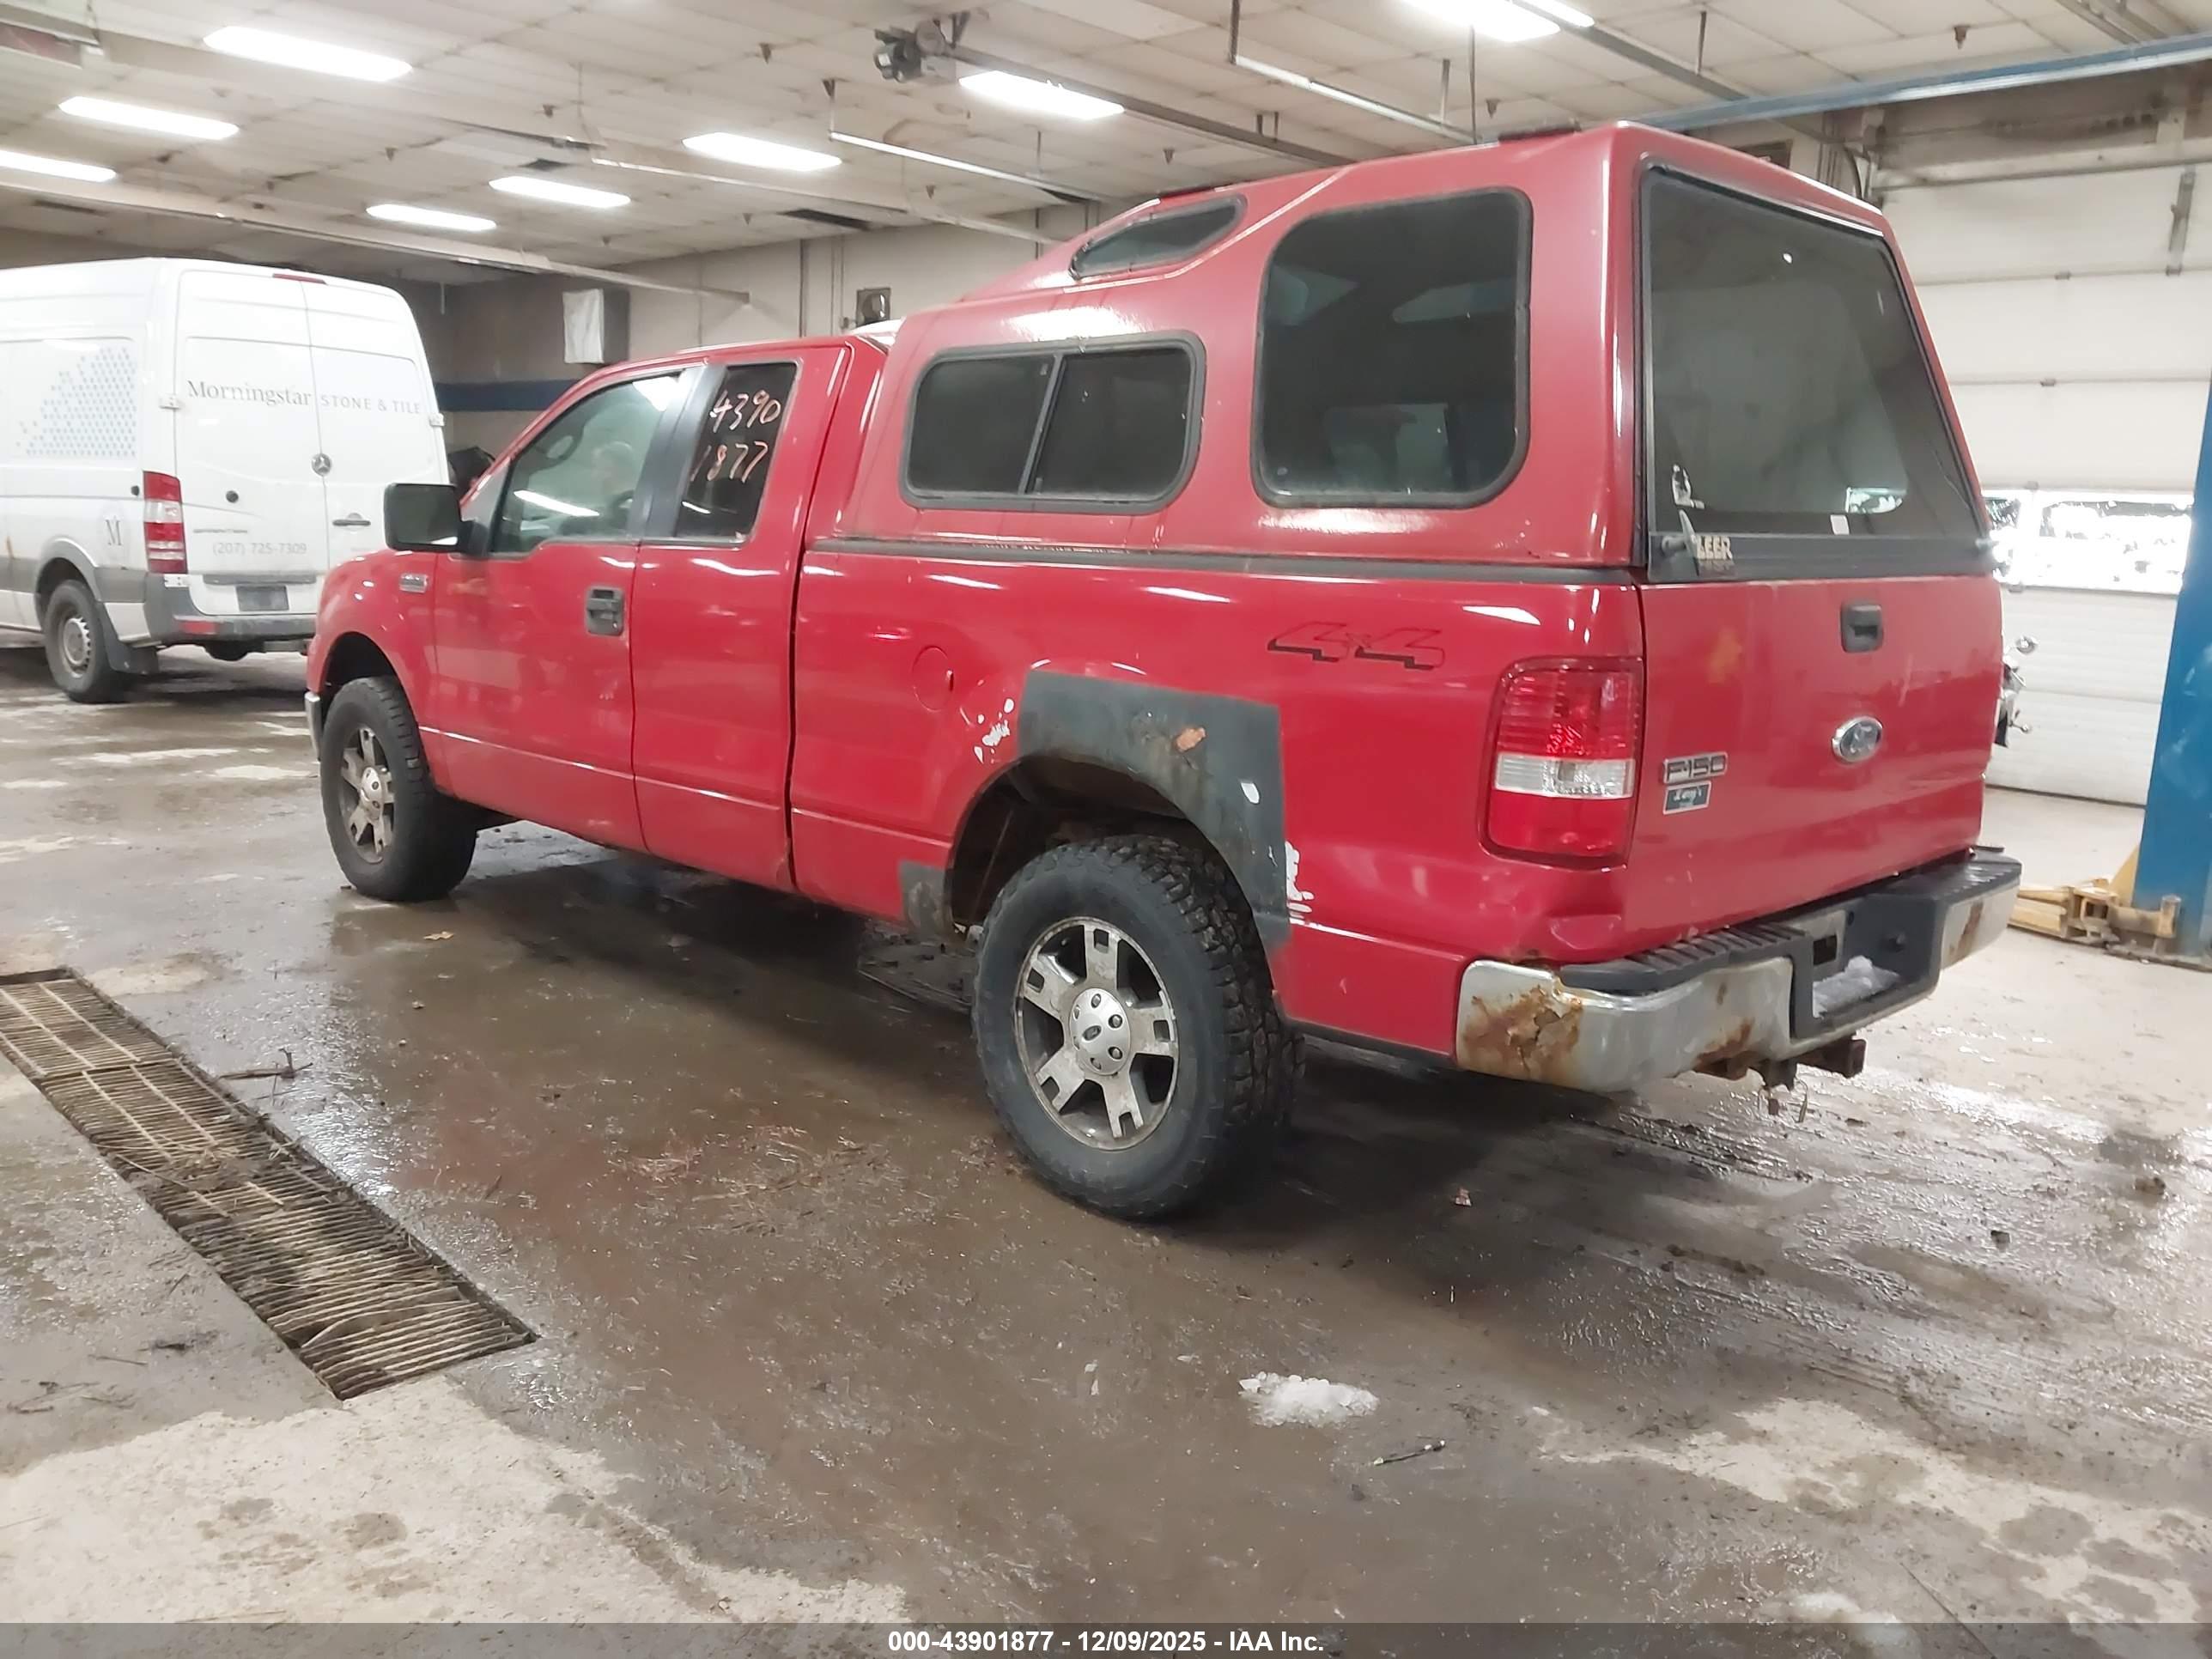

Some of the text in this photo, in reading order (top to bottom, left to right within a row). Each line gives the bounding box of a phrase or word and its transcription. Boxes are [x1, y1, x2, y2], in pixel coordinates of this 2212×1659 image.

[187, 380, 421, 414] Morningstar STONE & TILE
[710, 389, 781, 433] 4390
[690, 441, 769, 483] 1877
[213, 543, 245, 556] (207)
